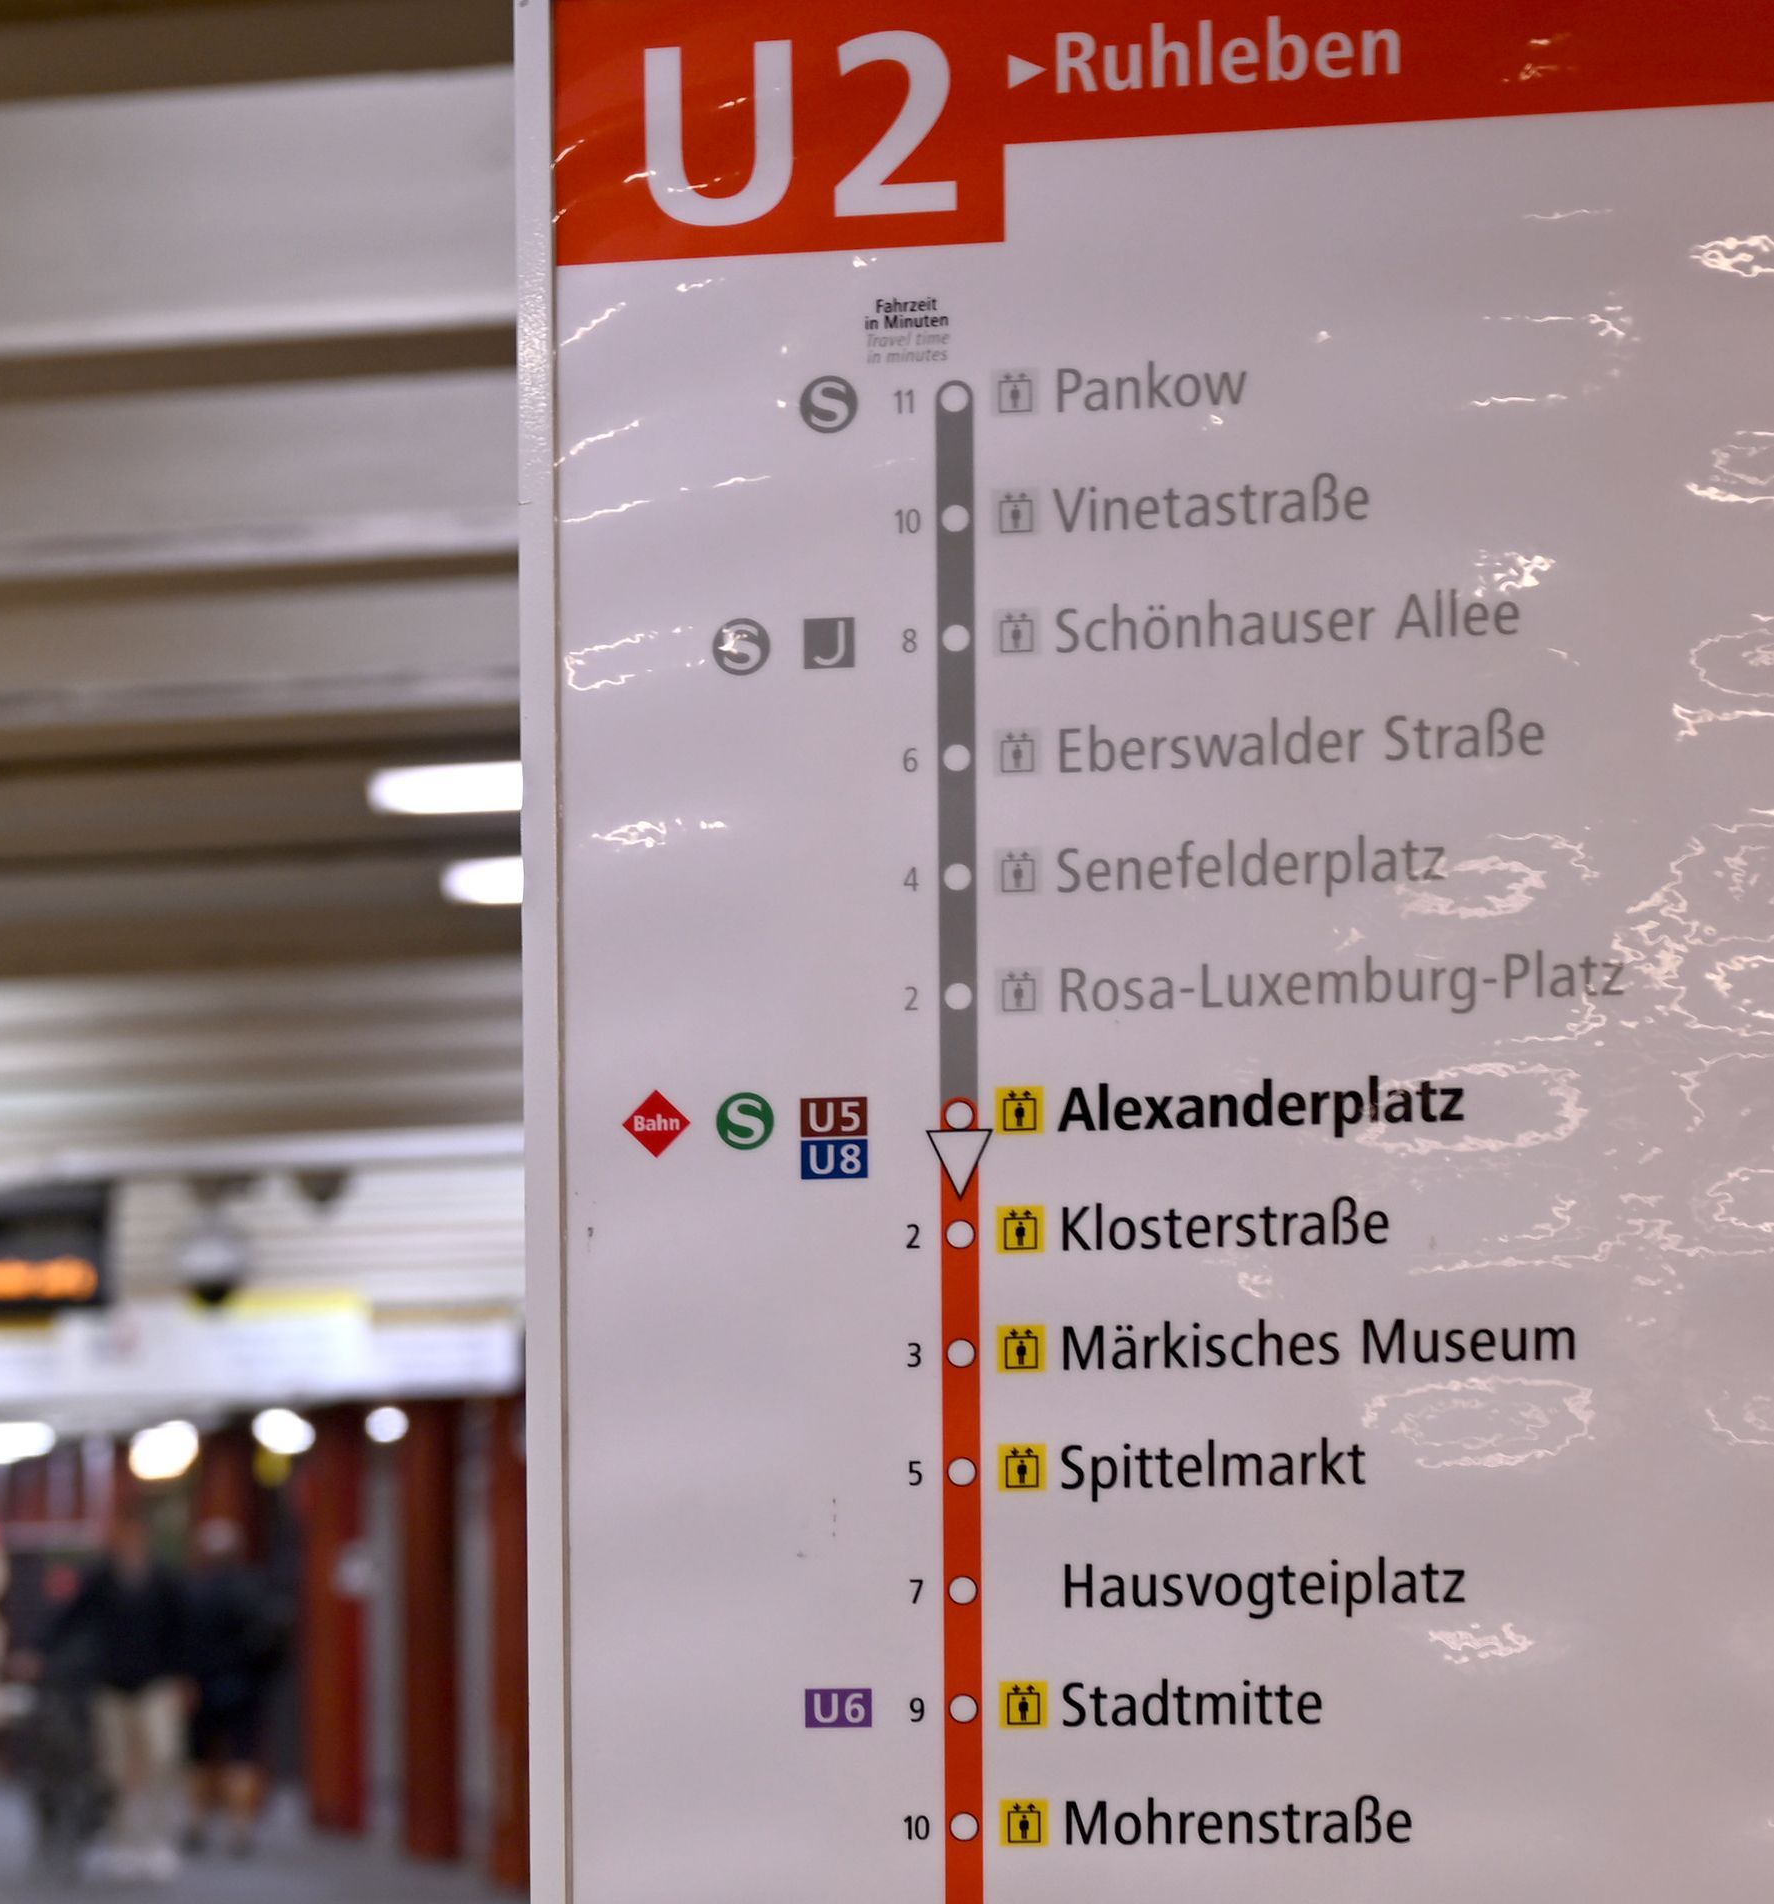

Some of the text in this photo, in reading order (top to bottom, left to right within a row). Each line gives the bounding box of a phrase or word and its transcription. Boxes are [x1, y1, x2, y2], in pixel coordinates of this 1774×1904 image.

[1056, 16, 1399, 93] Ruhleben
[644, 31, 957, 226] U2
[863, 314, 950, 330] in Minuten
[873, 295, 940, 314] Fahrzeit
[811, 382, 848, 427] S
[894, 389, 914, 414] 11
[1058, 361, 1247, 412] Pankow
[1053, 473, 1369, 532] Vinetastraße
[895, 509, 921, 534] 10
[1057, 589, 1519, 653] Schönhauser Allee
[717, 623, 761, 671] S
[902, 629, 917, 653] 8
[1060, 708, 1544, 773] Eberswalder Straße
[903, 748, 918, 772] 6
[904, 867, 919, 891] 4
[1058, 835, 1444, 897] Senefelderplatz
[905, 986, 918, 1011] 2
[1061, 950, 1624, 1014] Rosa-Luxemburg-Platz
[633, 1113, 681, 1132] Bahn
[726, 1099, 765, 1144] S
[810, 1102, 860, 1132] U5
[1058, 1075, 1464, 1138] Alexanderplatz
[810, 1144, 861, 1174] U8
[906, 1224, 920, 1248] 2
[1063, 1196, 1388, 1251] Klosterstraße
[908, 1343, 921, 1367] 3
[1063, 1319, 1574, 1370] Märkisches Museum
[909, 1461, 922, 1486] 5
[1062, 1437, 1365, 1501] Spittelmarkt
[910, 1579, 923, 1604] 7
[1065, 1556, 1465, 1619] Hausvogteiplatz
[814, 1693, 864, 1723] U6
[910, 1698, 924, 1722] 9
[1063, 1679, 1322, 1727] Stadtmitte
[904, 1816, 929, 1840] 10
[1066, 1795, 1411, 1845] Mohrenstraße
